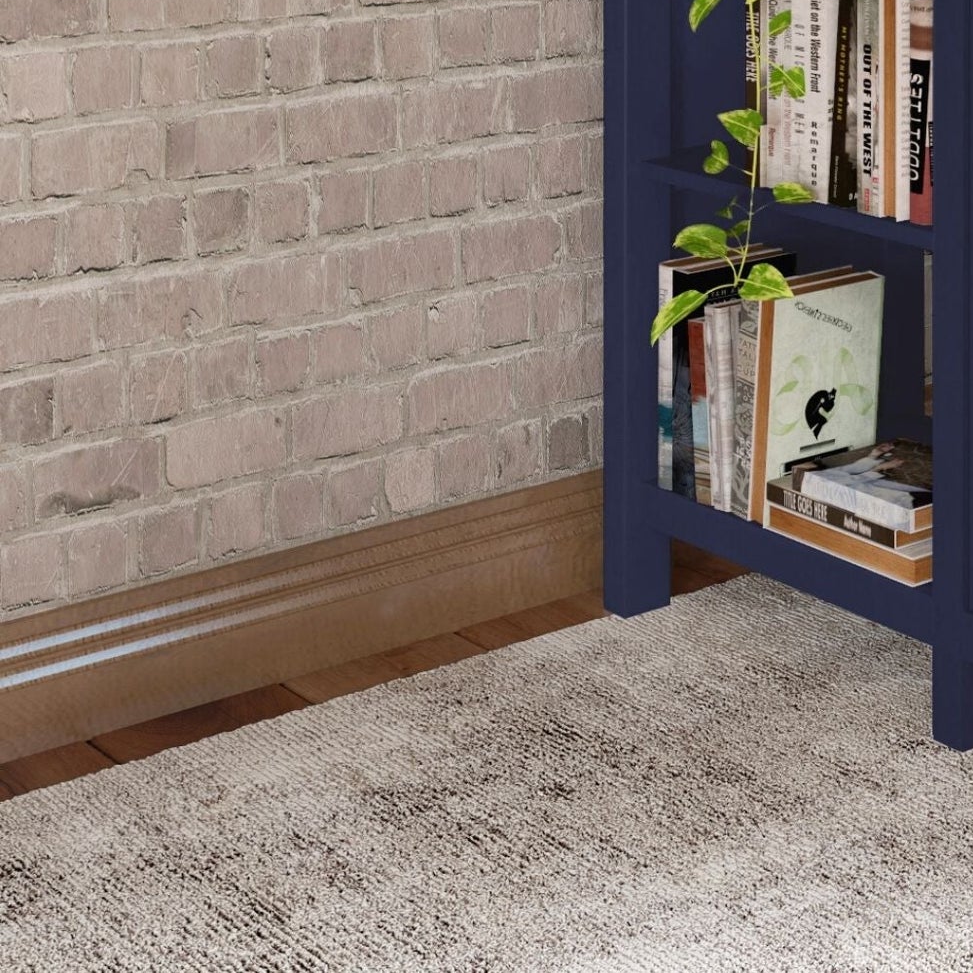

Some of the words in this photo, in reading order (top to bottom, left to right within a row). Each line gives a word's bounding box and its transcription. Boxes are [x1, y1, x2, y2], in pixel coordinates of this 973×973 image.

[810, 12, 819, 22] on
[810, 24, 821, 37] the
[810, 39, 821, 71] Western
[838, 46, 846, 92] MOTHER'S
[863, 44, 872, 75] OUT
[746, 60, 757, 83] HERE
[810, 72, 821, 94] Front
[863, 78, 872, 97] OF
[863, 101, 872, 129] THE
[863, 133, 872, 177] WEST
[783, 490, 796, 509] TITLE
[797, 495, 813, 517] GOES
[814, 501, 828, 522] HERE
